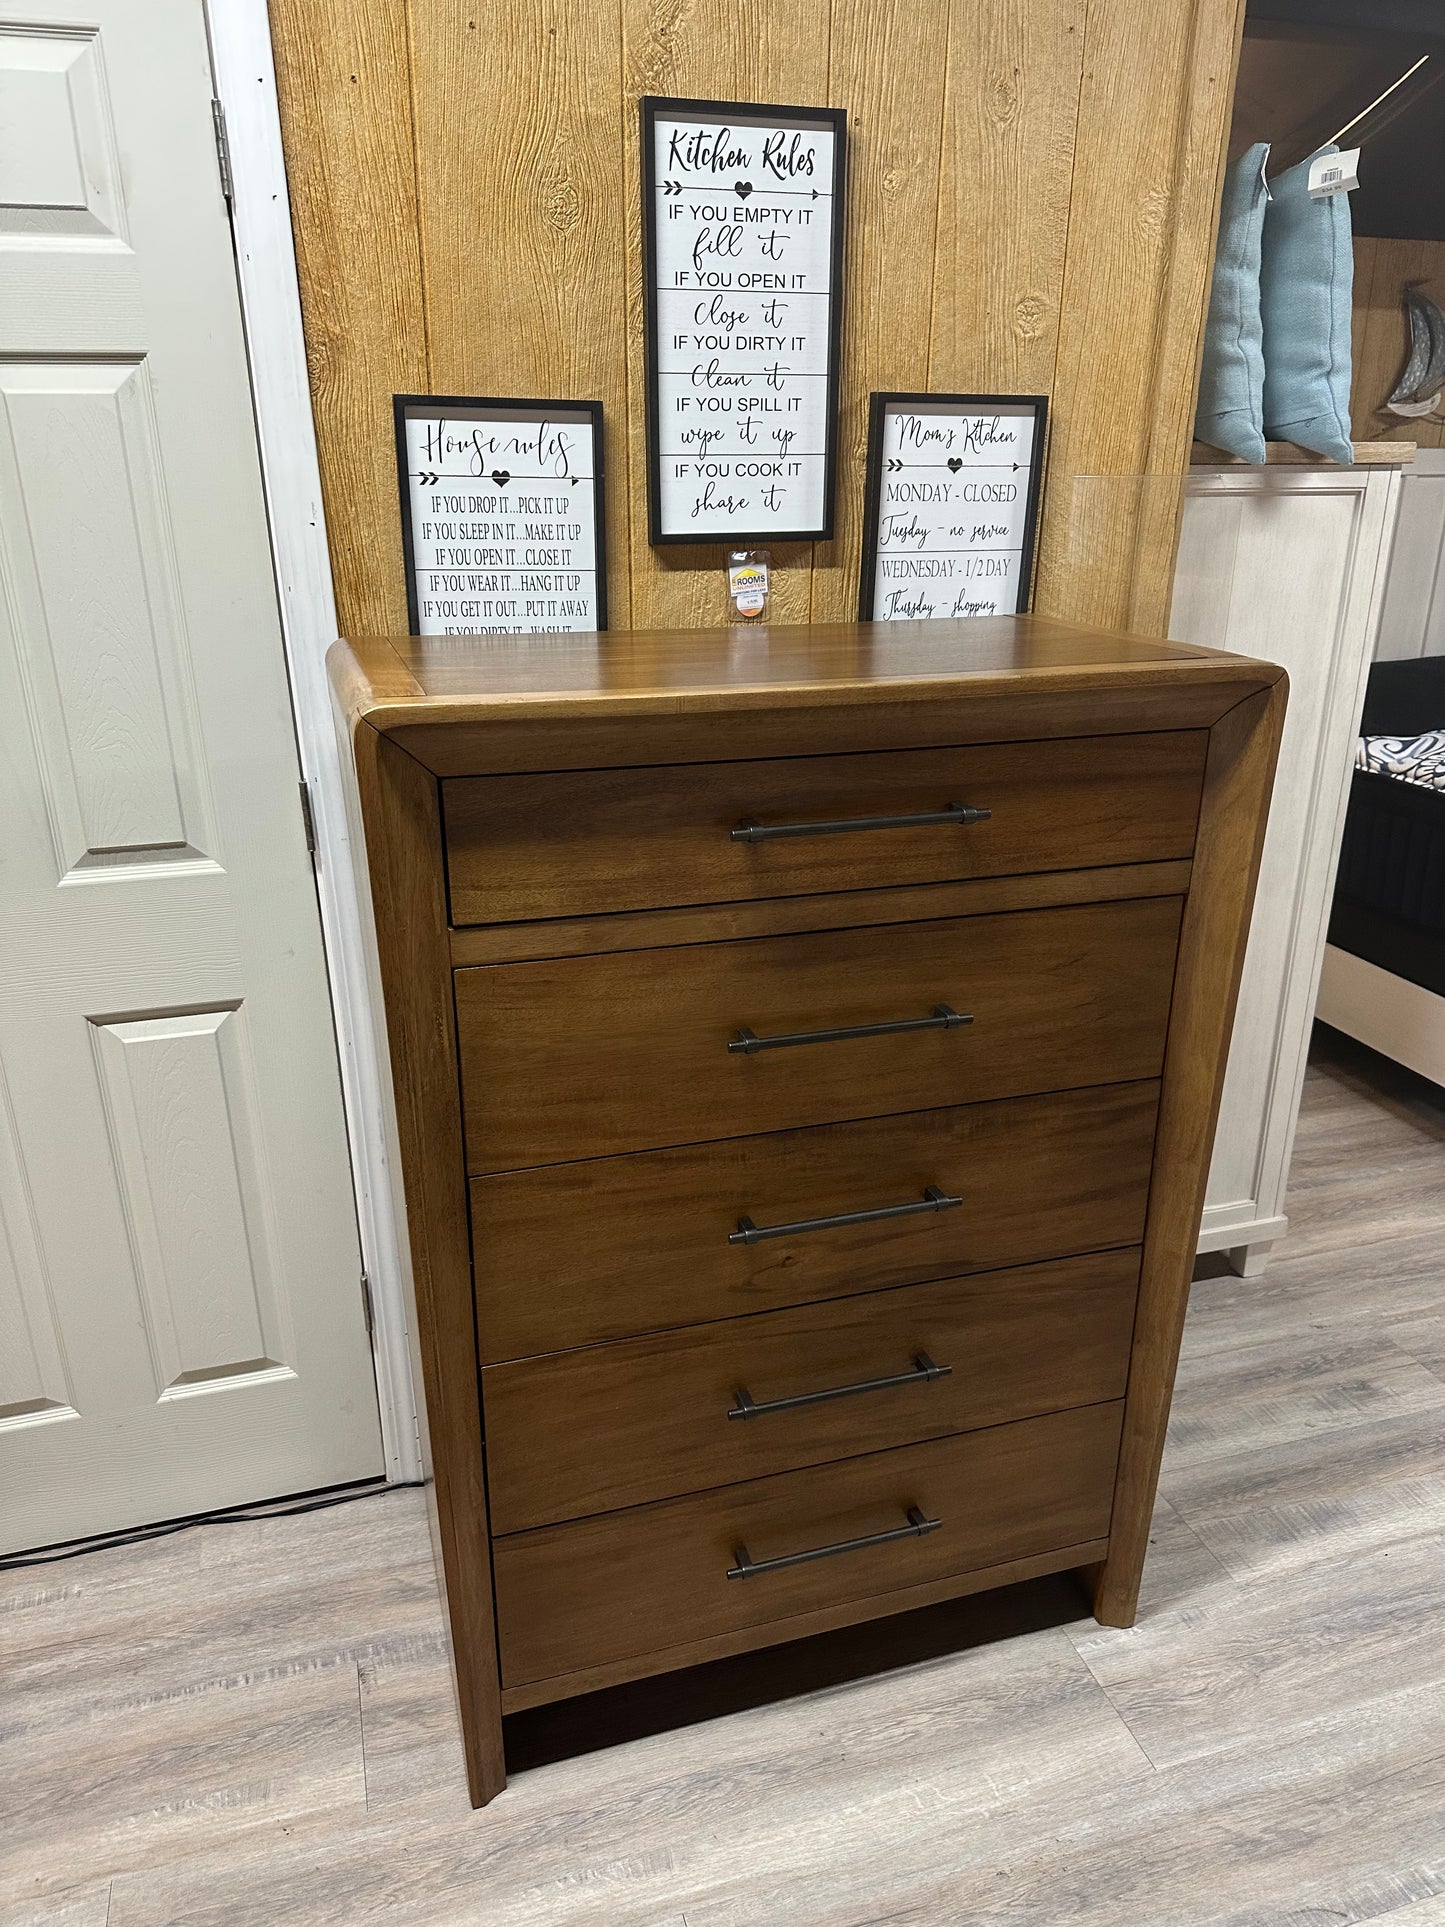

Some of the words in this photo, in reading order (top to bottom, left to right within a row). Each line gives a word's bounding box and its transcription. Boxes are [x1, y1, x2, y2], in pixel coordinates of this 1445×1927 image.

[669, 127, 752, 173] Kitchen
[762, 131, 816, 181] Rules
[669, 204, 684, 220] IF
[690, 205, 727, 222] YOU
[734, 207, 793, 224] EMPTY
[799, 209, 814, 225] IT
[692, 225, 744, 270] fill
[758, 230, 791, 261] it
[675, 271, 689, 286] IF
[695, 272, 732, 288] YOU
[738, 273, 786, 288] OPEN
[792, 275, 806, 289] IT
[694, 294, 750, 332] Close
[761, 298, 789, 328] it
[673, 335, 688, 350] IF
[694, 335, 730, 350] YOU
[736, 336, 786, 351] DIRTY
[791, 337, 806, 351] IT
[691, 358, 752, 388] Clean
[763, 362, 791, 391] it
[676, 398, 691, 412] IF
[696, 397, 732, 412] YOU
[737, 397, 782, 412] SPILL
[788, 398, 802, 412] IT
[681, 427, 725, 460] wipe
[736, 416, 764, 444] it
[772, 428, 797, 459] up
[895, 414, 957, 451] Mom's
[962, 413, 1017, 454] Kitchen
[419, 417, 501, 477] House
[504, 419, 576, 478] rules
[675, 464, 689, 478] IF
[694, 464, 730, 478] YOU
[735, 463, 783, 477] COOK
[788, 463, 802, 476] IT
[691, 481, 750, 517] share
[760, 484, 787, 512] it
[886, 483, 952, 502] MONDAY
[963, 483, 1017, 503] CLOSED
[431, 496, 442, 513] IF
[443, 496, 466, 514] YOU
[468, 496, 497, 514] DROP
[544, 497, 554, 514] IT
[555, 497, 569, 514] UP
[422, 523, 432, 540] IF
[435, 523, 457, 540] YOU
[459, 523, 490, 541] SLEEP
[492, 523, 504, 540] IN
[556, 524, 566, 541] IT
[568, 524, 581, 541] UP
[880, 511, 932, 549] Tuesday
[949, 525, 965, 537] no
[970, 524, 1010, 542] service
[435, 548, 446, 566] IF
[448, 548, 471, 566] YOU
[474, 548, 503, 566] OPEN
[561, 549, 572, 566] IT
[881, 559, 956, 578] WEDNESDAY
[965, 556, 983, 580] 1/2
[985, 558, 1011, 577] DAY
[430, 575, 441, 592] IF
[443, 575, 466, 591] YOU
[468, 575, 498, 592] WEAR
[554, 575, 564, 592] IT
[566, 575, 580, 592] UP
[737, 575, 766, 586] ROOMS
[423, 600, 434, 618] IF
[435, 600, 458, 618] YOU
[460, 600, 481, 618] GET
[483, 600, 493, 617] IT
[547, 600, 558, 617] IT
[560, 600, 589, 617] AWAY
[882, 588, 936, 621] Thursday
[950, 588, 998, 617] shopping
